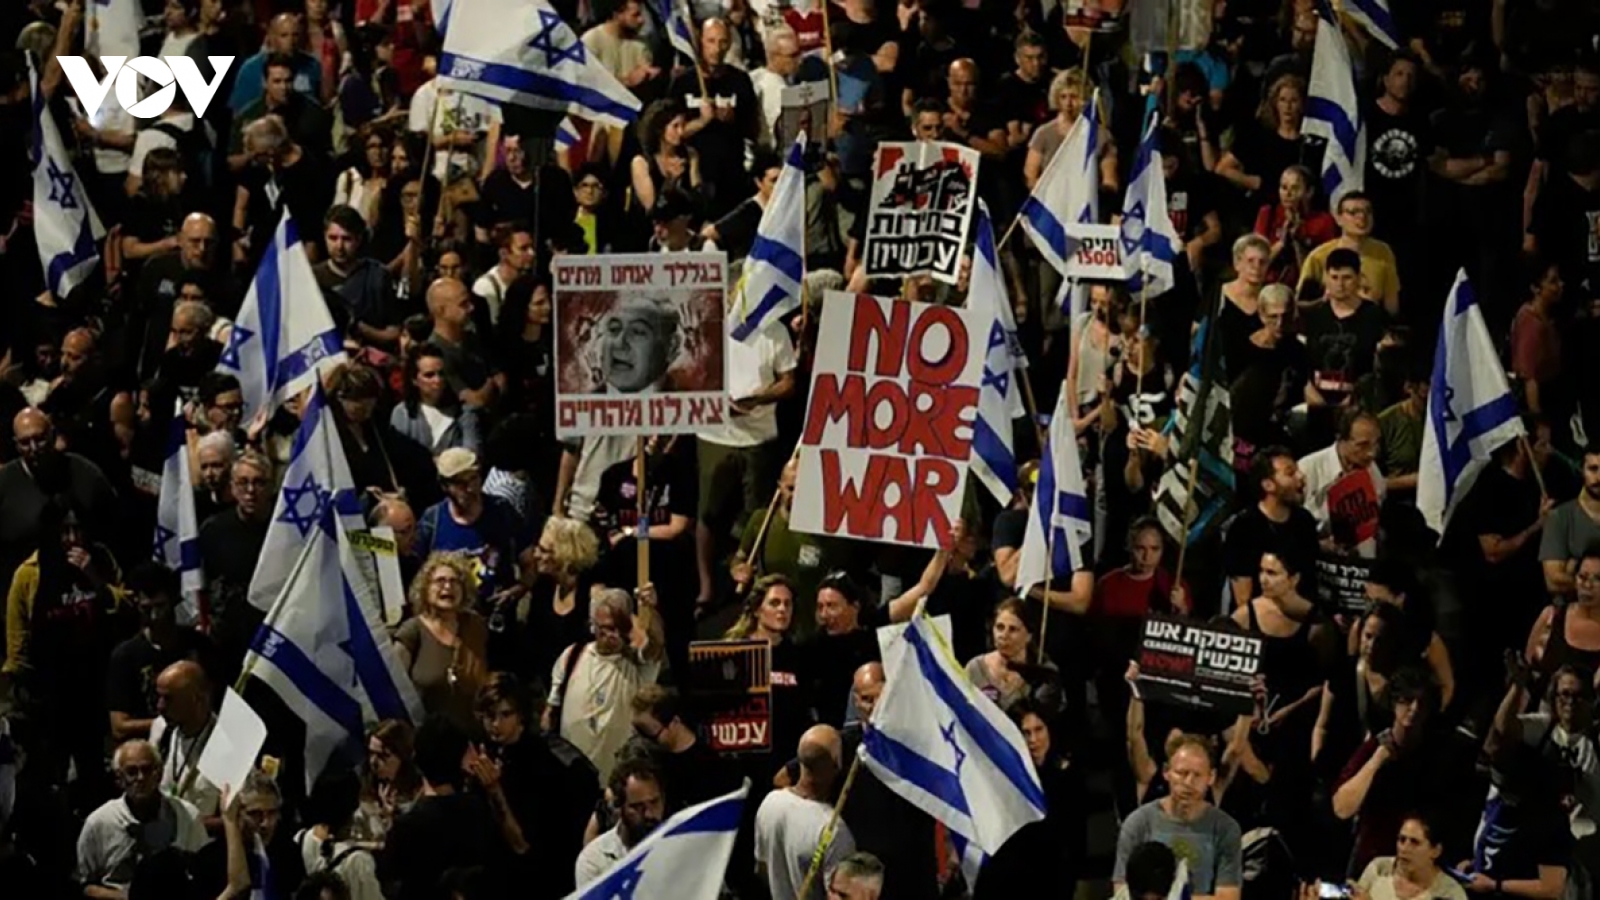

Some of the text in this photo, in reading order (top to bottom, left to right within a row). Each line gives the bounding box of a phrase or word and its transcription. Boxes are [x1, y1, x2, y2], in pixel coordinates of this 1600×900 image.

[870, 213, 962, 238] בחירות
[870, 241, 957, 271] עכשיו!
[1076, 250, 1115, 266] 1500
[1081, 237, 1114, 252] תיק
[557, 261, 722, 286] בגללך אנחנו מתים
[847, 293, 969, 386] NO
[558, 395, 724, 428] צא לנו מהחיים
[803, 374, 981, 461] MORE
[820, 449, 956, 550] WAR
[1145, 620, 1262, 656] הפסקת אש
[1197, 648, 1258, 674] עכשיו
[705, 721, 767, 746] עכשי
